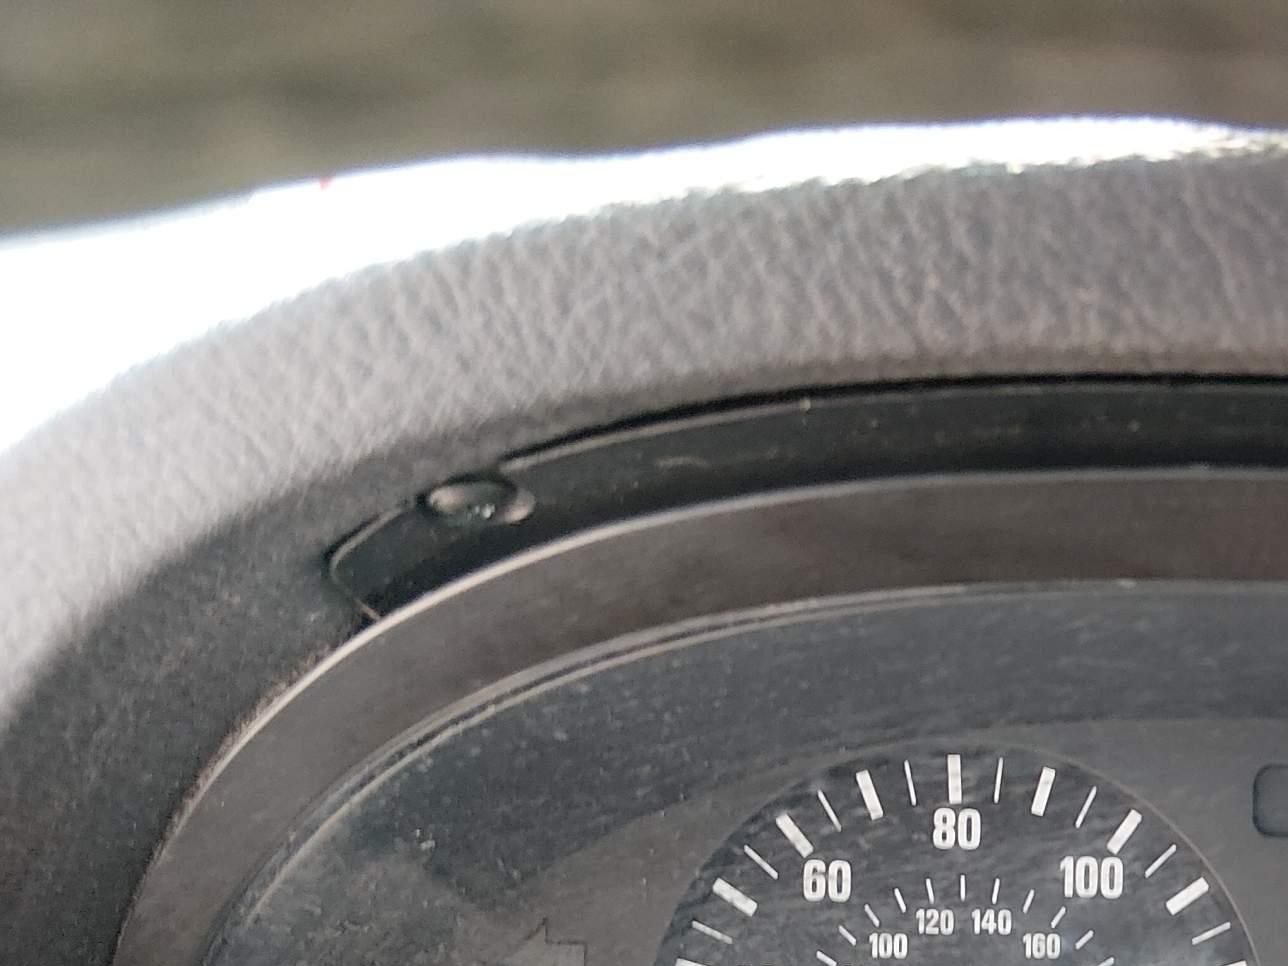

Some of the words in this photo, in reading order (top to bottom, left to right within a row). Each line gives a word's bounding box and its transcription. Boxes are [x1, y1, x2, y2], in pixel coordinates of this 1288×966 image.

[932, 808, 981, 850] 80
[803, 859, 852, 903] 60
[1060, 856, 1124, 899] 100
[915, 909, 955, 936] 120
[972, 909, 1013, 936] 140
[869, 932, 908, 959] 100
[1022, 933, 1062, 959] 160
